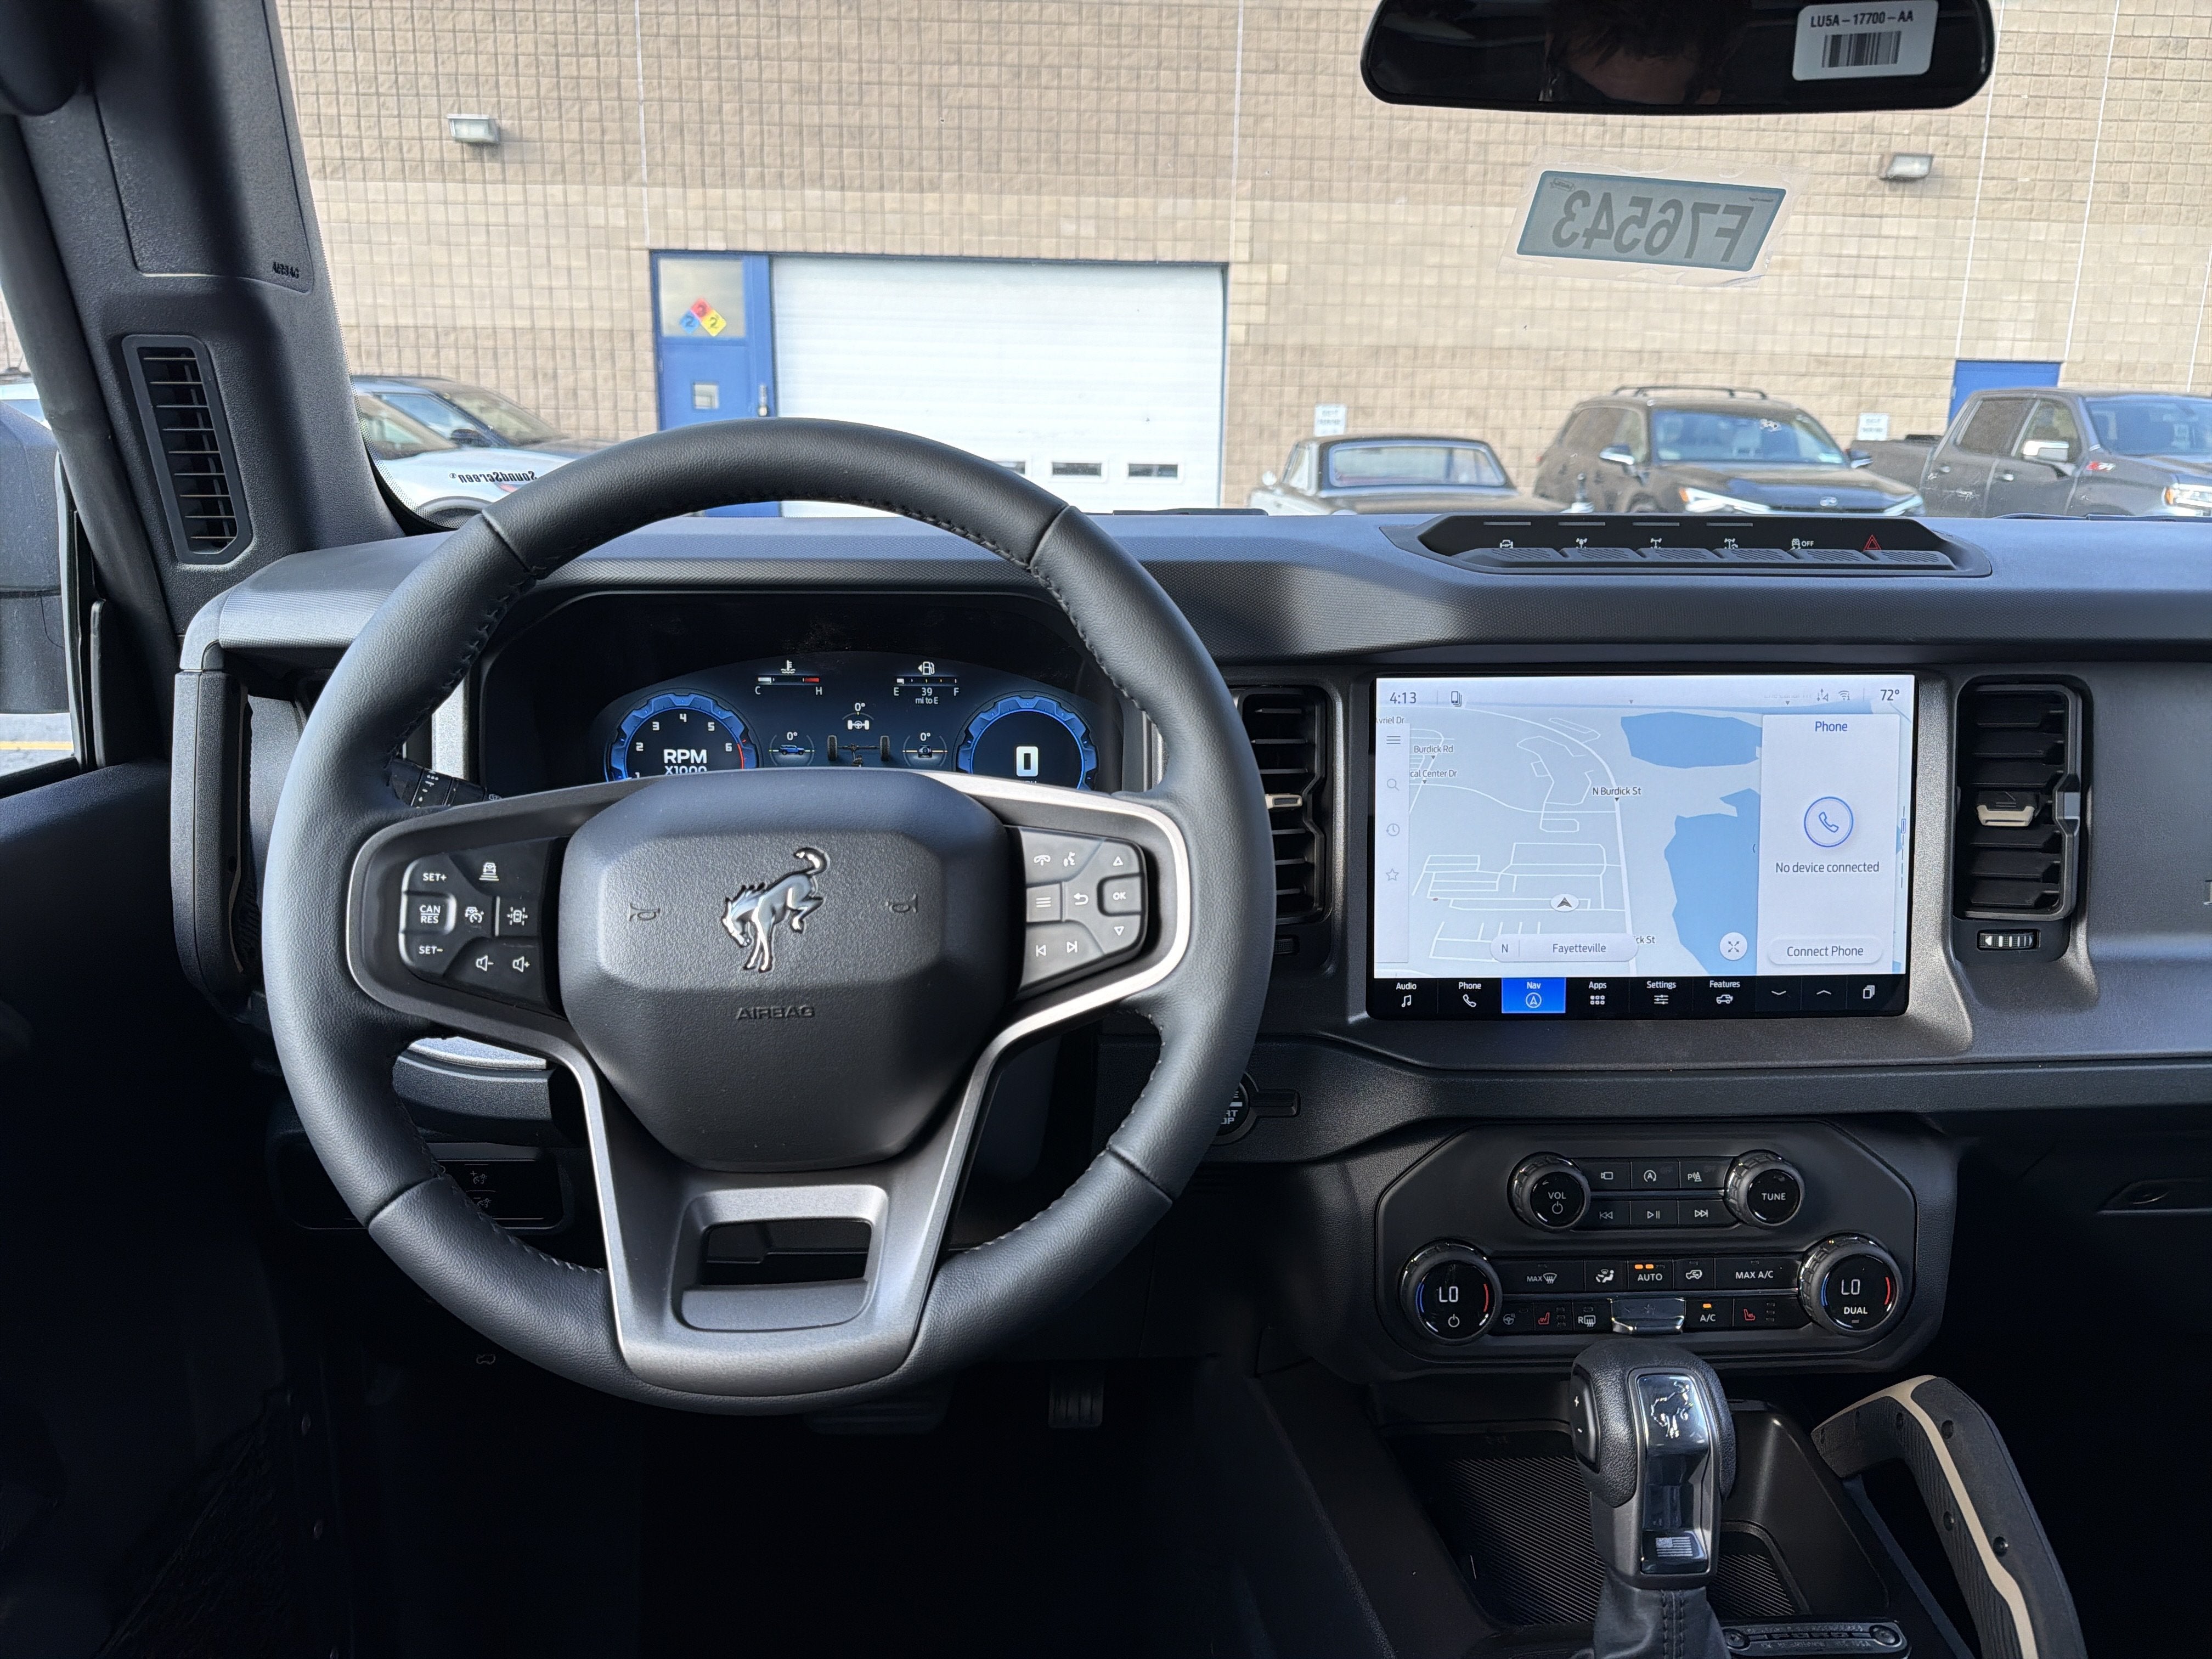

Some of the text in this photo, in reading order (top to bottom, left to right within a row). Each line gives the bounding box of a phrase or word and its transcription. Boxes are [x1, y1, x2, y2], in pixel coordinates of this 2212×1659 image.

[755, 686, 761, 695] C
[815, 686, 822, 696] H
[894, 687, 899, 697] E
[921, 687, 933, 697] 39
[953, 687, 960, 697] F
[1389, 691, 1417, 704] 4:13
[1880, 689, 1900, 702] 72°
[854, 702, 866, 712] 0°
[680, 714, 687, 723] 4
[1376, 716, 1405, 724] vriel Dr
[653, 722, 659, 731] 3
[708, 723, 715, 731] 5
[1815, 721, 1848, 733] Phone
[787, 732, 798, 741] 0°
[919, 732, 931, 741] 0°
[635, 742, 644, 751] 2
[725, 743, 732, 752] 6
[1414, 745, 1453, 753] Burdick Rd
[663, 749, 708, 764] RPM
[1015, 746, 1039, 777] 0
[1423, 769, 1448, 778] Center
[1449, 769, 1458, 778] Dr
[1593, 786, 1642, 796] N Burdick St
[1776, 861, 1880, 873] No device connected
[1113, 891, 1127, 900] OK
[420, 905, 441, 913] CAN
[1634, 935, 1656, 944] ck St
[1502, 944, 1509, 953] N
[1553, 942, 1606, 955] Fayetteville
[1786, 945, 1864, 957] Connect Phone
[1396, 981, 1417, 991] Audio
[1458, 981, 1482, 991] Phone
[1527, 981, 1541, 990] Nav
[1588, 981, 1607, 991] Apps
[1646, 980, 1677, 990] Settings
[1709, 980, 1741, 989] Features
[736, 1005, 816, 1020] AIRBAG
[1548, 1192, 1566, 1200] VOL
[1761, 1193, 1786, 1201] TUNE
[1637, 1273, 1663, 1282] AUTO
[1758, 1271, 1774, 1279] A/C
[1841, 1279, 1861, 1295] LO
[1438, 1286, 1459, 1303] LO
[1843, 1306, 1867, 1315] DUAL
[1700, 1314, 1716, 1323] A/C
